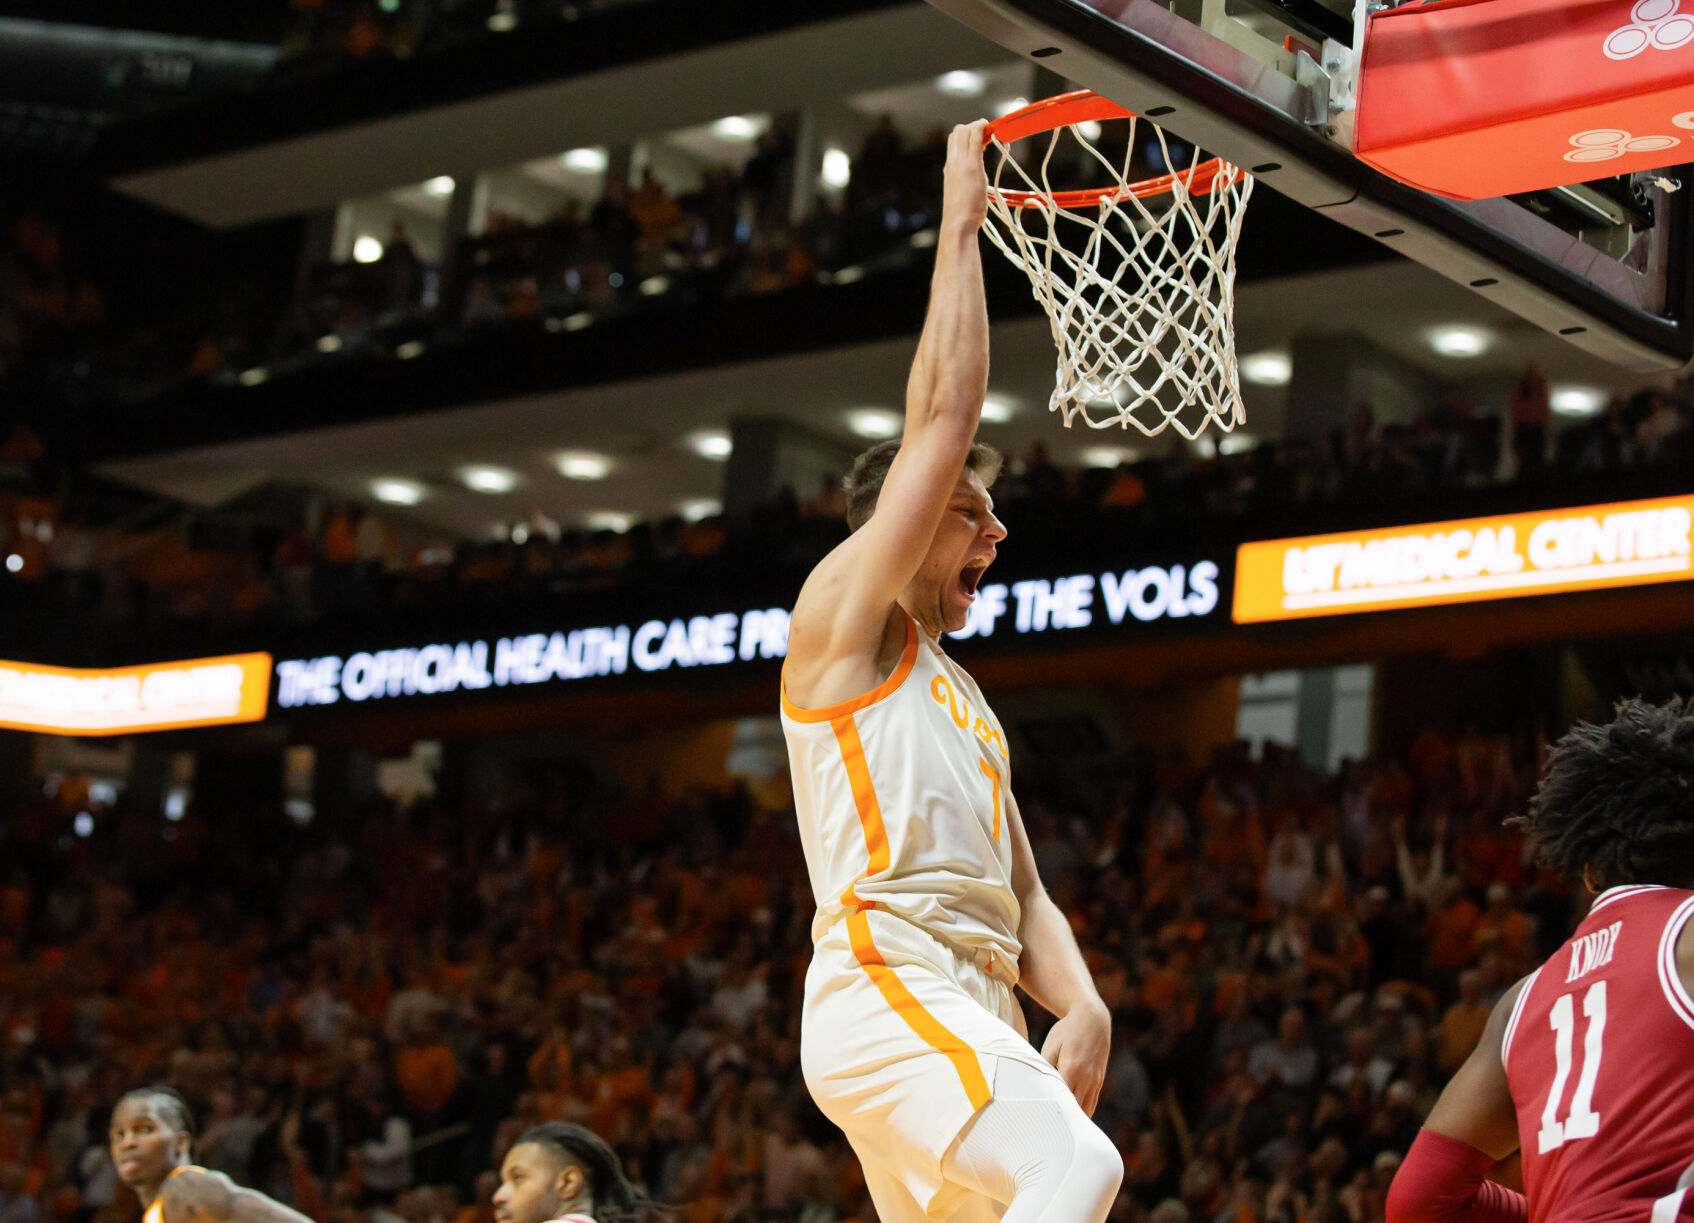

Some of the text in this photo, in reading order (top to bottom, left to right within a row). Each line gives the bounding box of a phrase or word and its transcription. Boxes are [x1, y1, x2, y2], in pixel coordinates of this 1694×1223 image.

[1339, 525, 1524, 590] MEDICAL
[1528, 507, 1692, 570] CENTER
[276, 656, 343, 708] THE
[341, 640, 493, 701] OFFICIAL
[494, 625, 631, 687] HEALTH
[631, 612, 739, 672] CARE
[1011, 574, 1096, 634] THE
[1100, 560, 1219, 624] VOLS
[1564, 920, 1623, 984] KNOX
[1537, 980, 1608, 1155] 11
